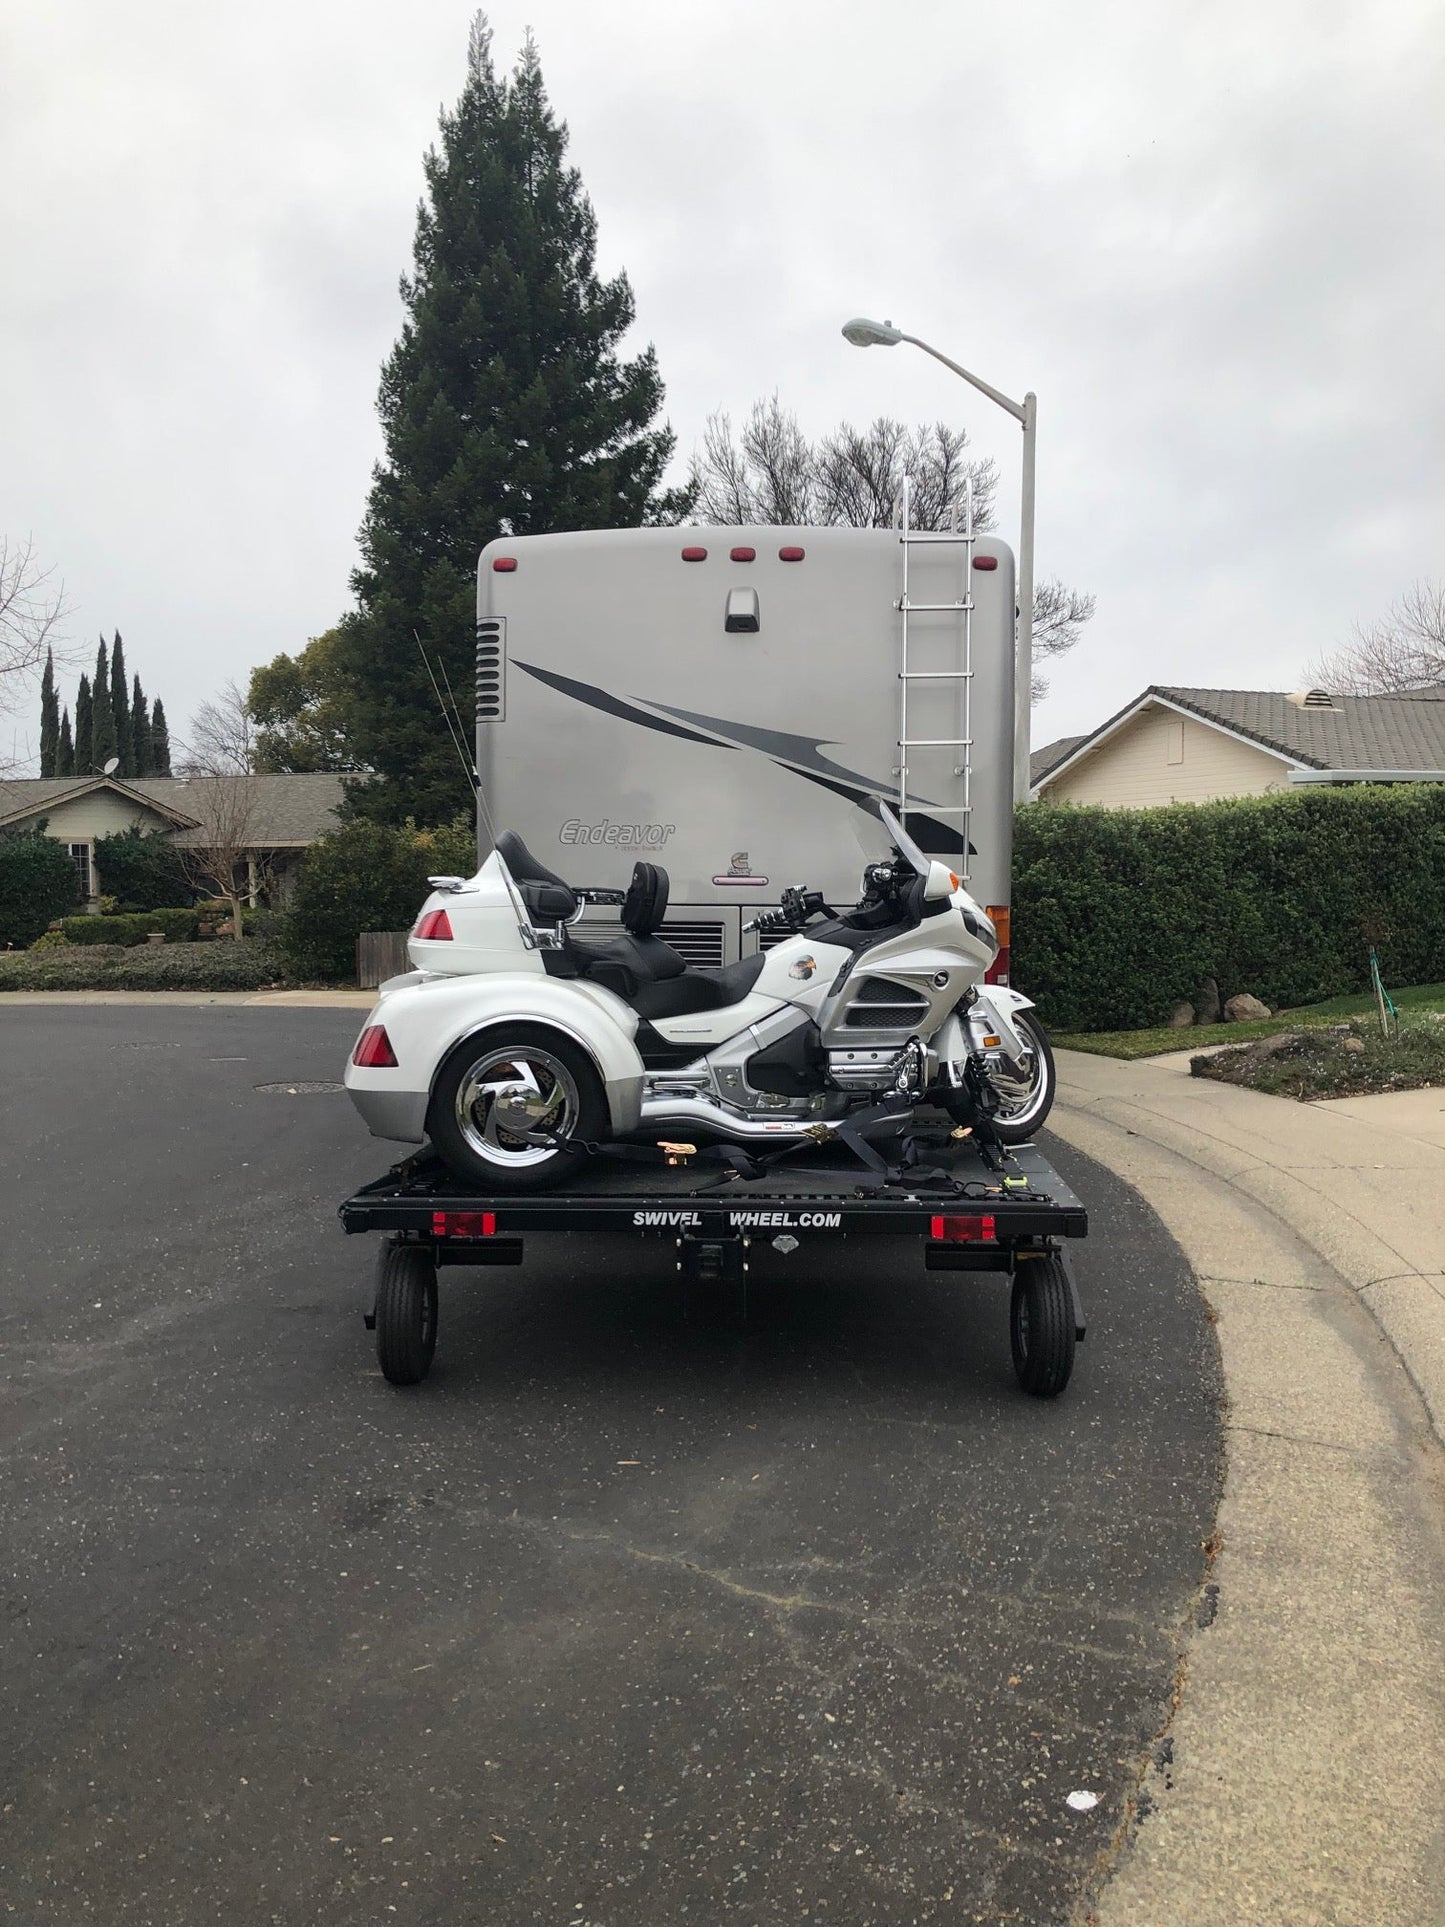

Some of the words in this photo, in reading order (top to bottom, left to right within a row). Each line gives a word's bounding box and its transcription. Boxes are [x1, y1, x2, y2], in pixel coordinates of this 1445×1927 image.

[559, 818, 676, 844] Endeavor
[633, 1212, 702, 1226] SWIVEL
[729, 1212, 841, 1227] WHEEL.COM
